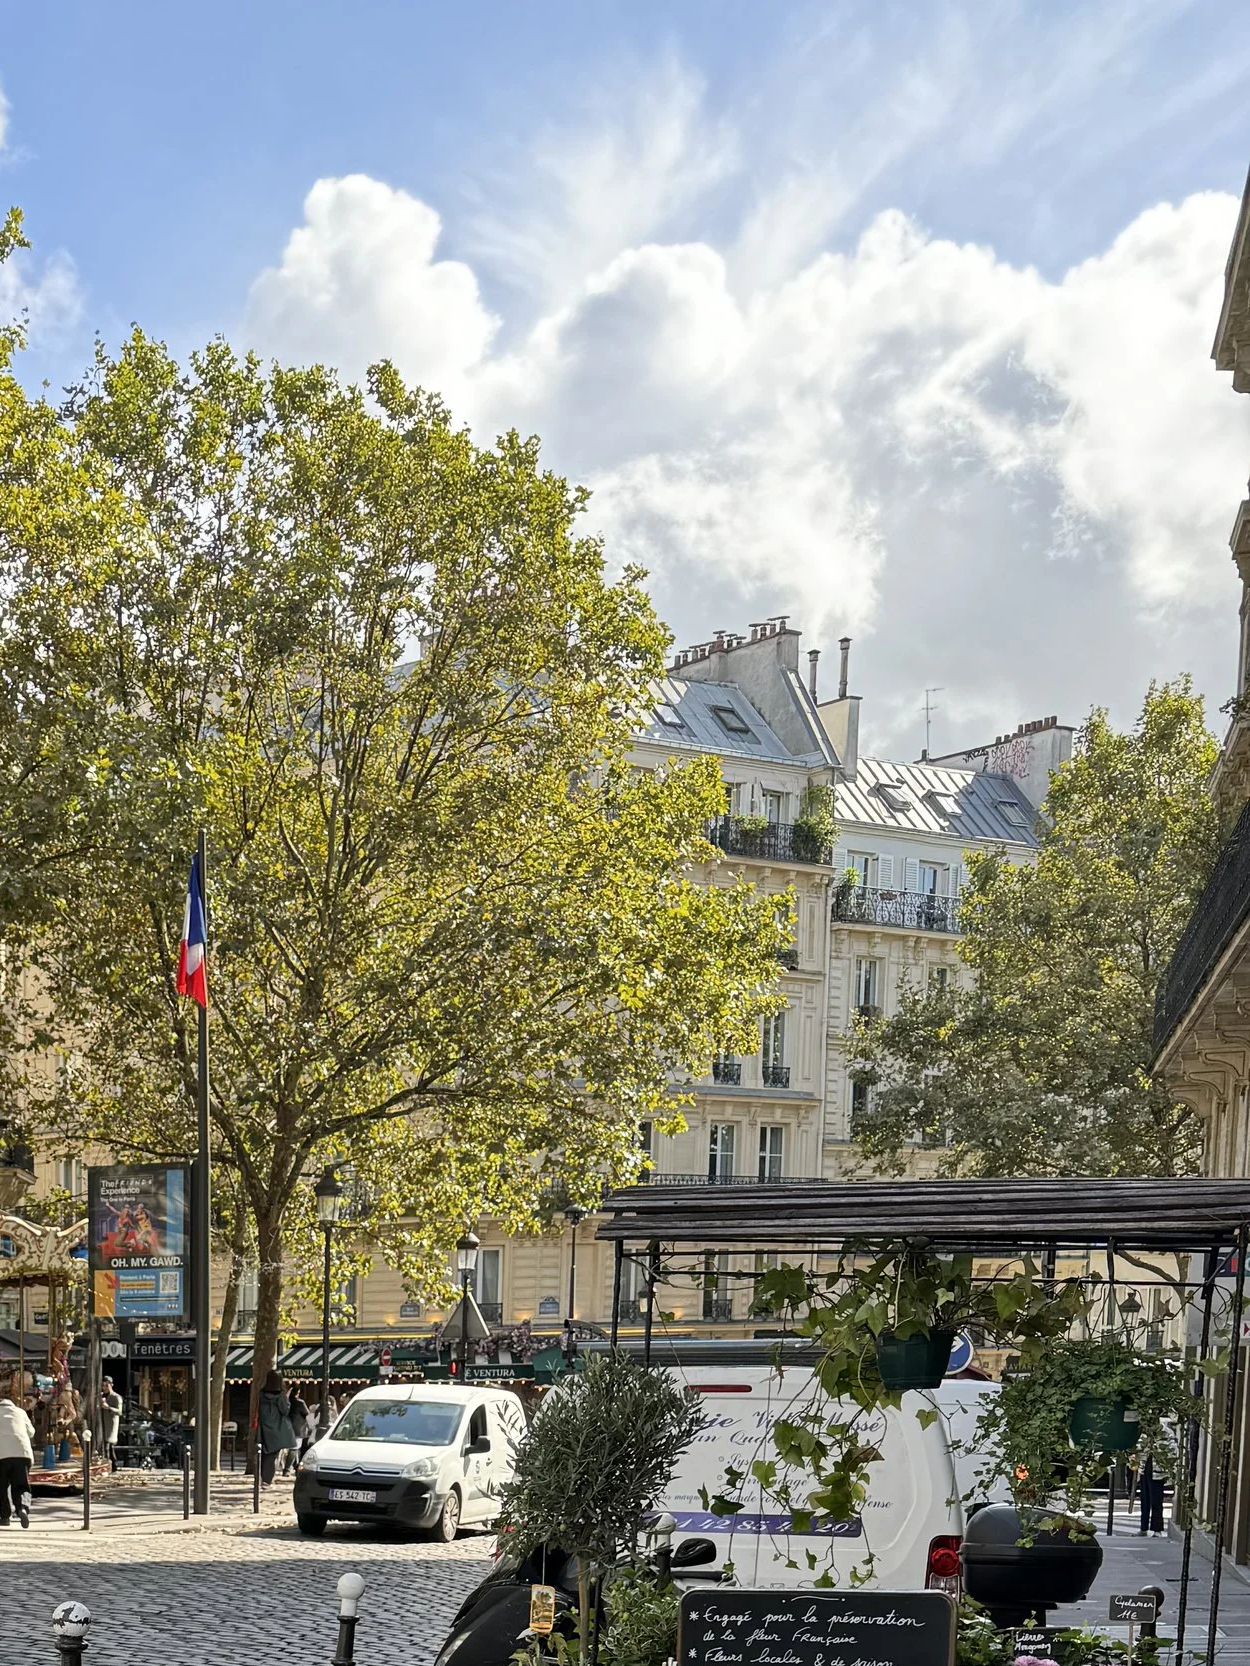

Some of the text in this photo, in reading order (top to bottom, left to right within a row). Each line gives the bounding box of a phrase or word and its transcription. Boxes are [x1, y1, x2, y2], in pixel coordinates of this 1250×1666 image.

[111, 1256, 184, 1268] OH. MY. GAWD.
[133, 1342, 191, 1355] fenêtres
[283, 1368, 314, 1377] VENTURA
[473, 1368, 516, 1378] VENTURA
[698, 1519, 731, 1530] 42
[1114, 1594, 1155, 1610] Cyclamen
[703, 1605, 926, 1632] Engagé pour la préservation
[703, 1628, 716, 1642] de
[720, 1628, 736, 1641] la
[746, 1629, 782, 1647] fleur
[705, 1647, 743, 1662] Fleurs
[750, 1648, 804, 1664] locales
[814, 1653, 826, 1666] &
[831, 1654, 846, 1666] de
